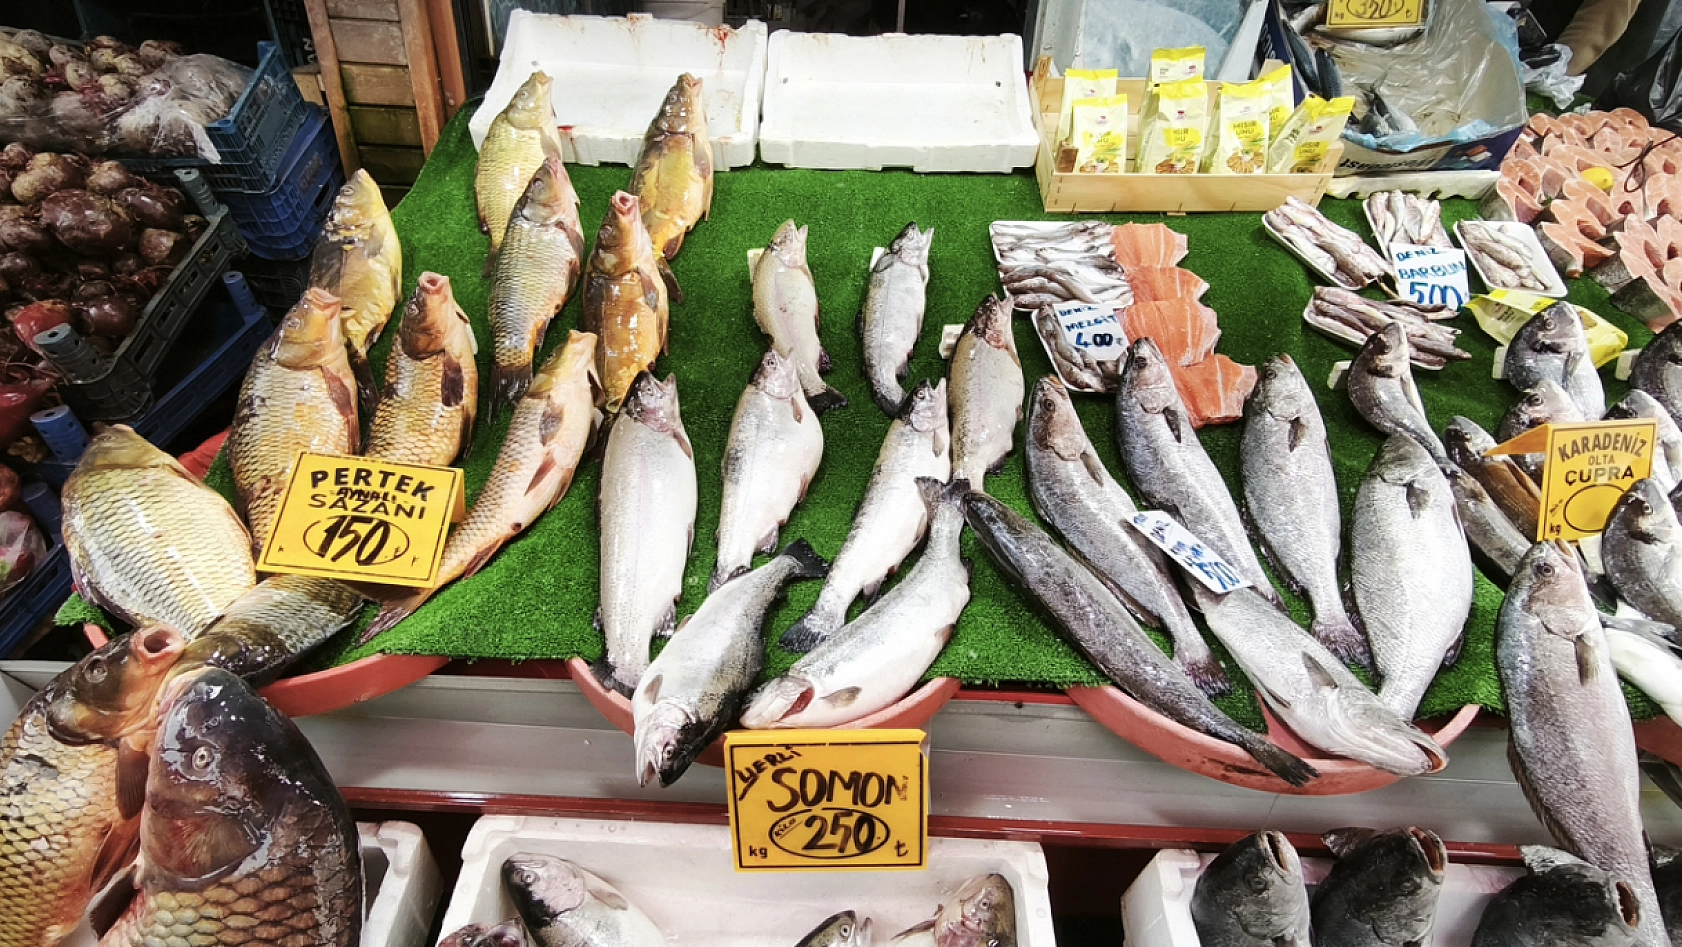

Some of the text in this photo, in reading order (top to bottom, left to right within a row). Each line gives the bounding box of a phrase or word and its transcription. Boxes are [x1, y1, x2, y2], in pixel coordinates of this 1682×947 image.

[1558, 431, 1647, 463] KARADENİZ
[1587, 453, 1616, 467] OLTA
[310, 467, 435, 502] PERTEK
[1565, 464, 1635, 487] ÇUPRA
[307, 493, 427, 520] SAZANI
[317, 515, 391, 567] 150
[766, 766, 905, 813] SOMON
[801, 811, 877, 854] 250
[749, 845, 768, 859] kg
